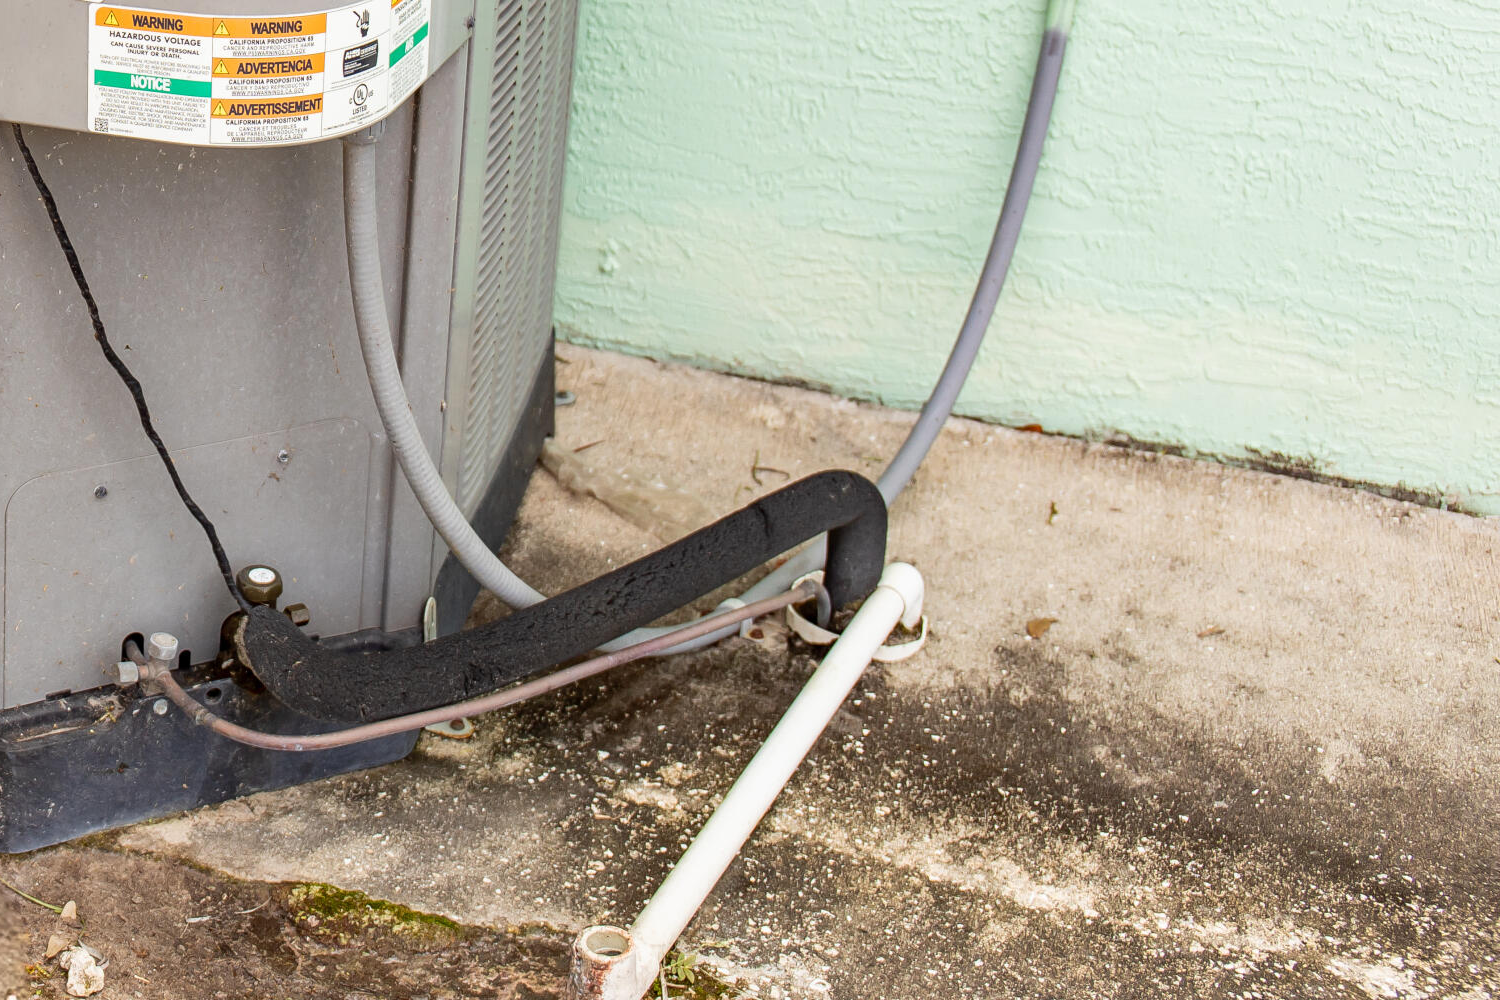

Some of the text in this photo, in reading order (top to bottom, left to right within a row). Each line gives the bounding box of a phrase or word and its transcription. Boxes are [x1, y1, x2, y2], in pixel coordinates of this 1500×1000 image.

[132, 14, 184, 32] WARNING
[251, 20, 302, 34] WARNING
[109, 30, 201, 47] HAZARDOUS VOLTAGE
[168, 47, 200, 56] PERSONAL
[237, 58, 313, 75] ADVERTENCIA
[130, 74, 172, 92] NOTICE
[266, 76, 304, 84] PROPOSITION
[228, 98, 322, 116] ADVERTISSEMENT
[353, 105, 367, 115] LISTED
[263, 117, 301, 125] PROPOSITION
